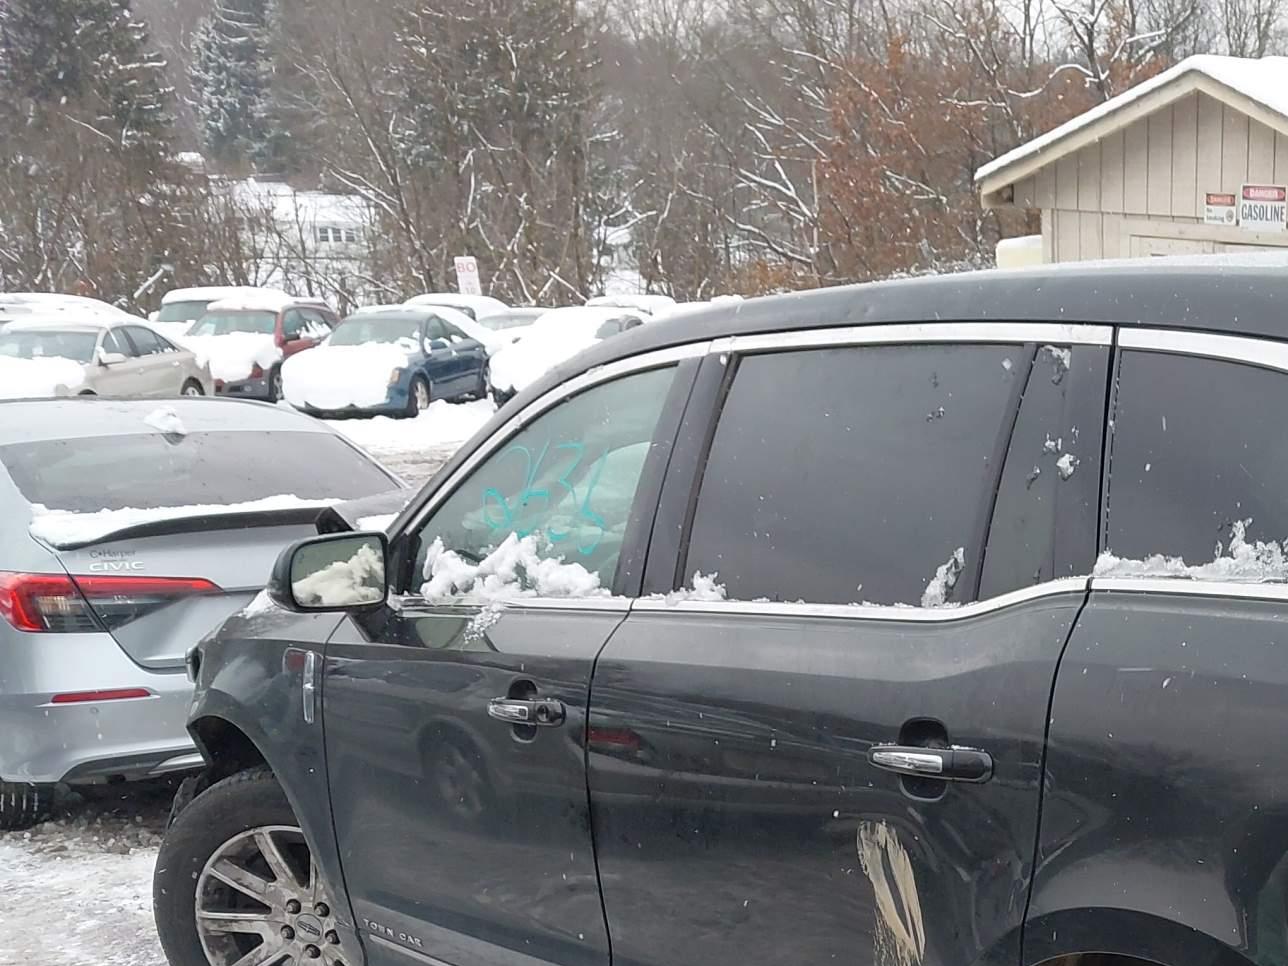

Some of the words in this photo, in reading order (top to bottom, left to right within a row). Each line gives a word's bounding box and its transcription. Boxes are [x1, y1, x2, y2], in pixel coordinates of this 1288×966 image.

[1241, 204, 1286, 223] GASOLINE
[89, 561, 145, 572] CIVIC
[363, 918, 394, 938] TOWN
[399, 932, 423, 947] CAR
